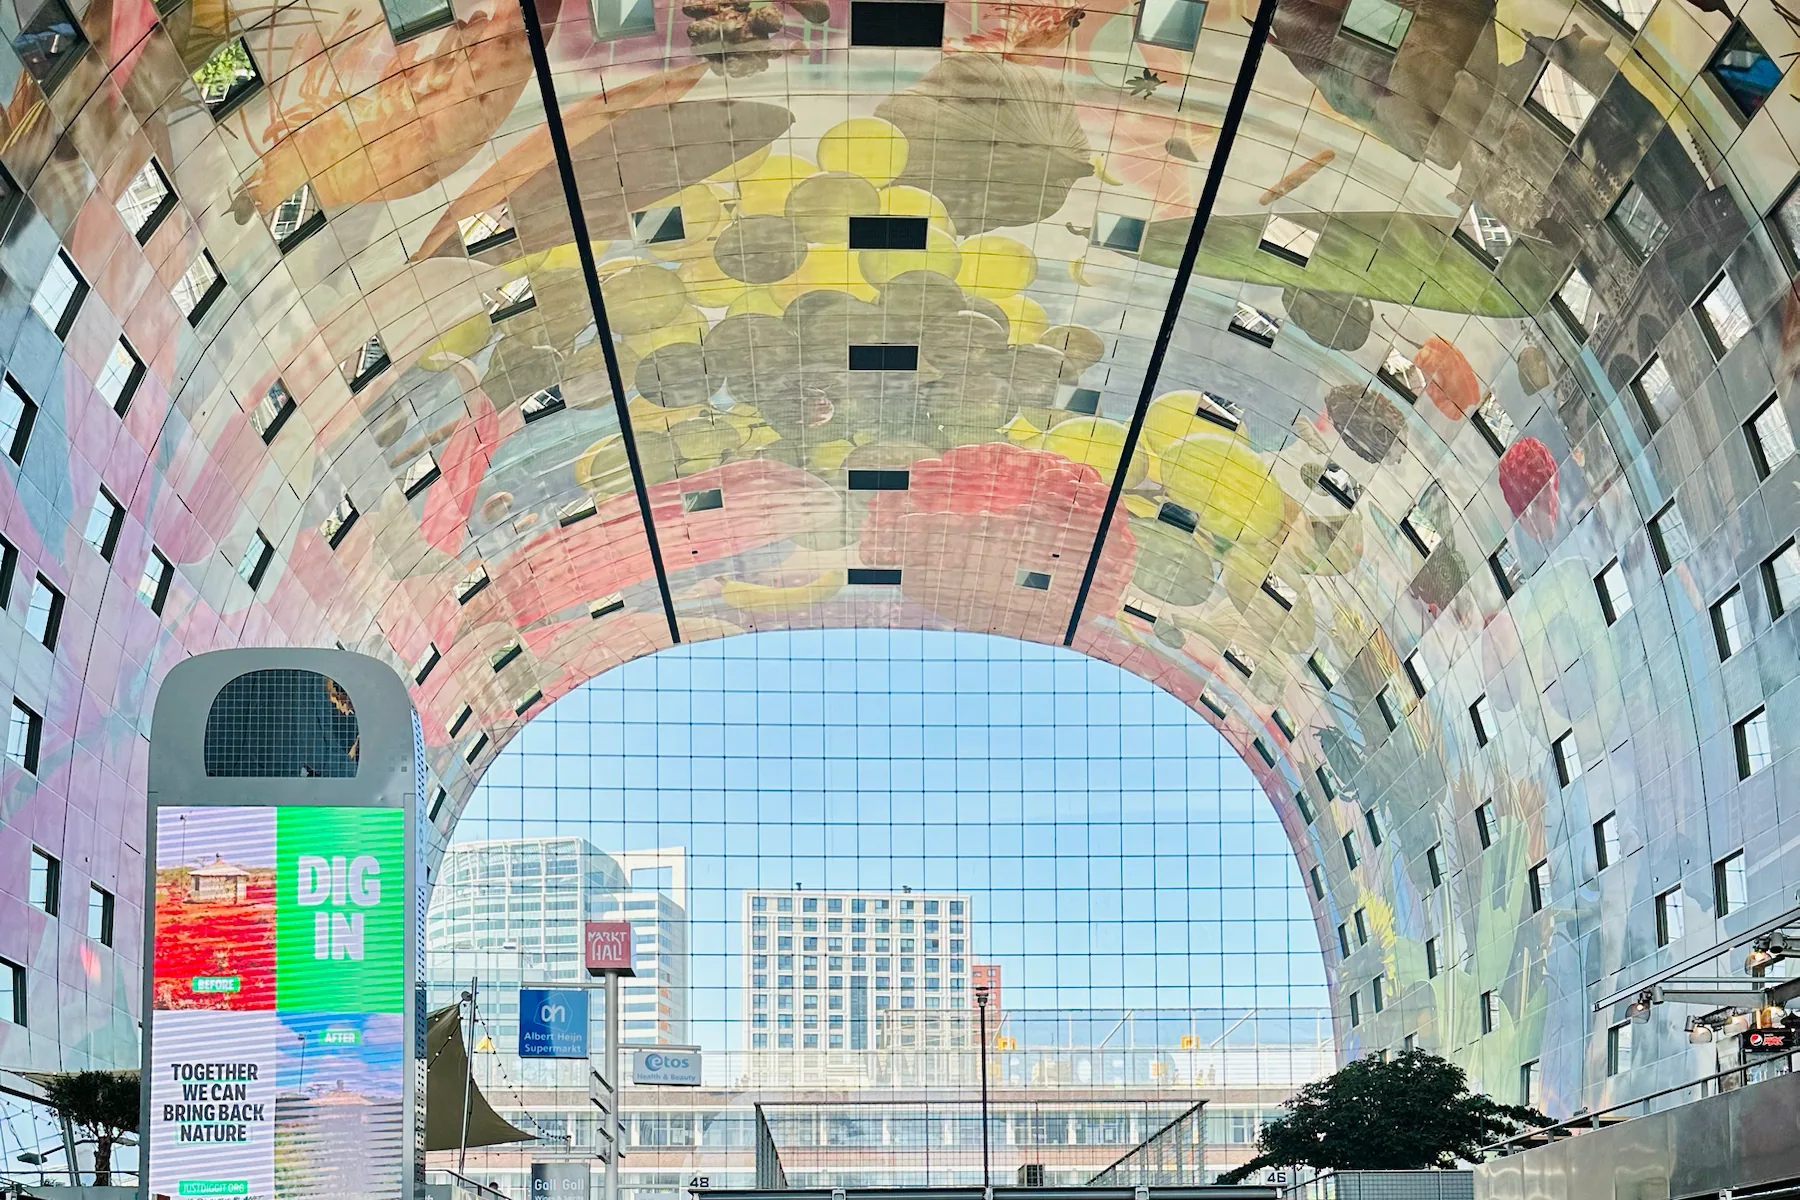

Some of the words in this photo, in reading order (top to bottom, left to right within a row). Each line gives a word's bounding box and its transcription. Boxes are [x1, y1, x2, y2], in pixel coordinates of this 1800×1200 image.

[297, 855, 381, 906] DIG
[314, 912, 364, 960] IN
[588, 932, 627, 942] MARKT
[592, 944, 621, 960] HAL
[198, 979, 235, 990] BEFORE
[324, 1033, 356, 1043] AFTER
[524, 1032, 555, 1041] Albert
[557, 1032, 582, 1043] Heijn
[525, 1044, 581, 1053] Supermarkt
[645, 1053, 689, 1071] etos
[171, 1063, 259, 1081] TOGETHER
[637, 1073, 661, 1081] Health
[671, 1074, 696, 1082] Beauty
[183, 1084, 208, 1101] WE
[211, 1084, 246, 1101] CAN
[163, 1104, 215, 1121] BRING
[219, 1104, 264, 1121] BACK
[180, 1124, 247, 1142] NATURE
[690, 1177, 709, 1188] 48
[1267, 1172, 1286, 1182] 46
[534, 1179, 556, 1190] Gall
[562, 1178, 584, 1190] Gall
